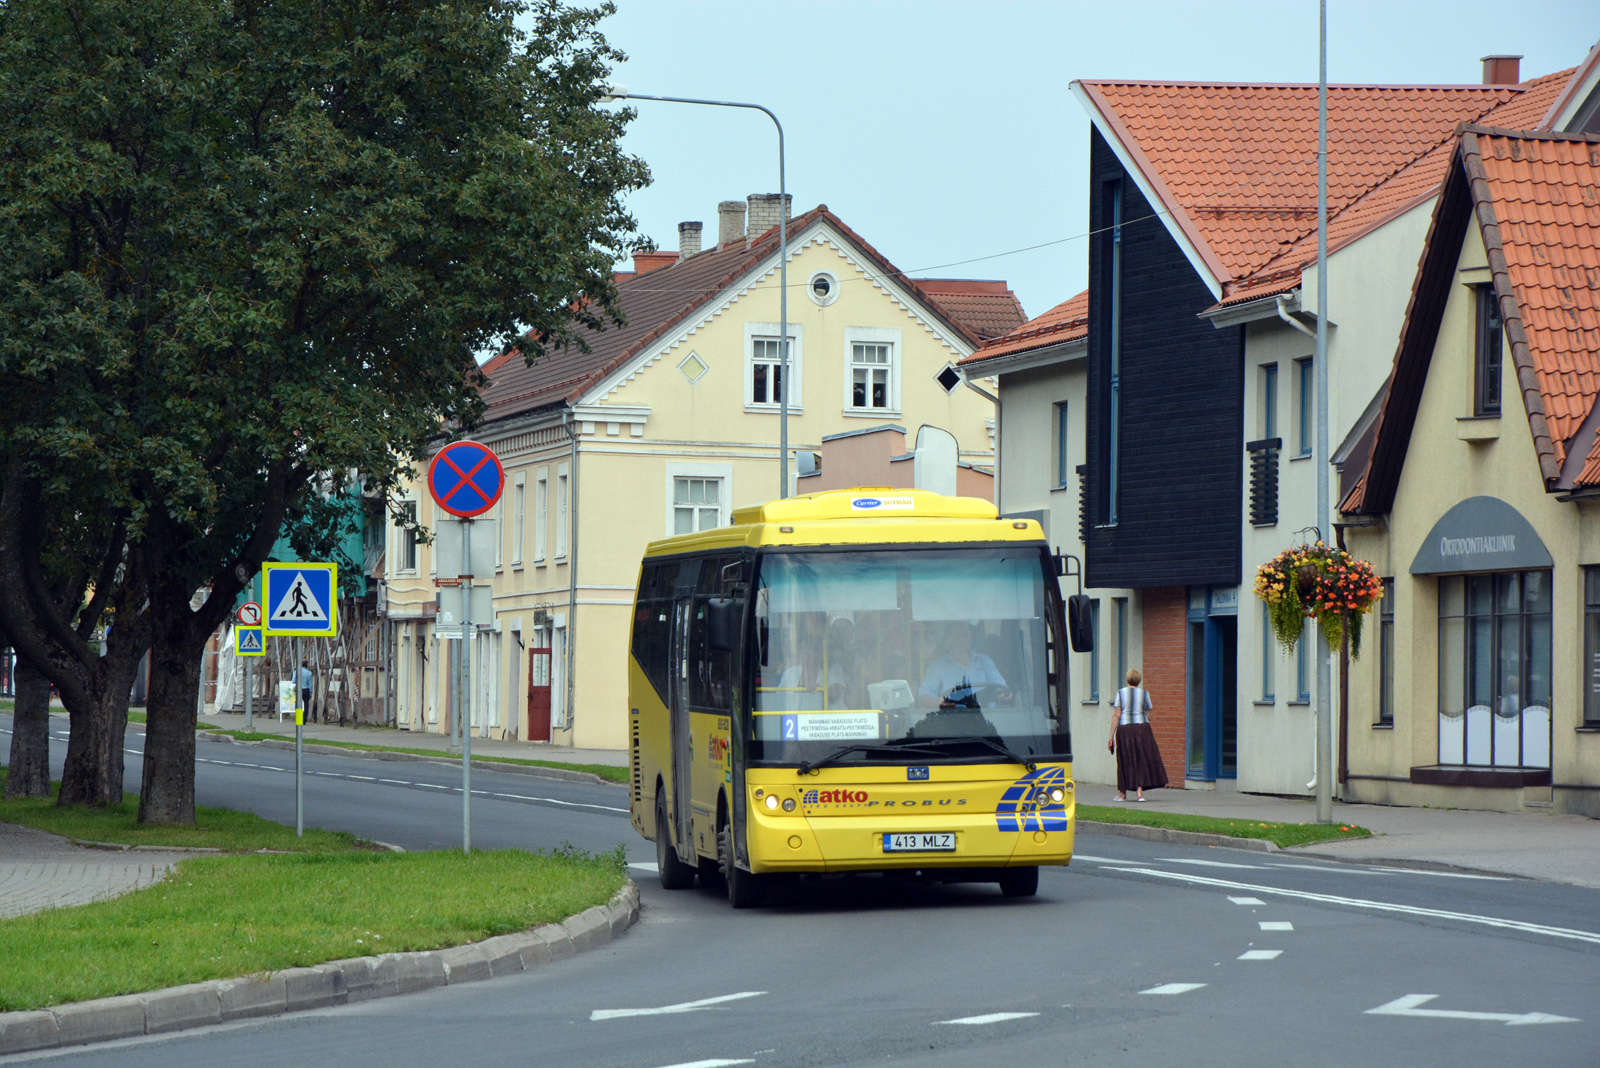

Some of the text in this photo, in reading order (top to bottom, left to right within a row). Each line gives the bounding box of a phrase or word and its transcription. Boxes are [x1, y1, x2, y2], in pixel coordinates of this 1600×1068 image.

[786, 719, 794, 738] 2
[819, 789, 868, 803] atko
[868, 799, 967, 807] PROBUS
[895, 836, 950, 847] 413 MLZ
